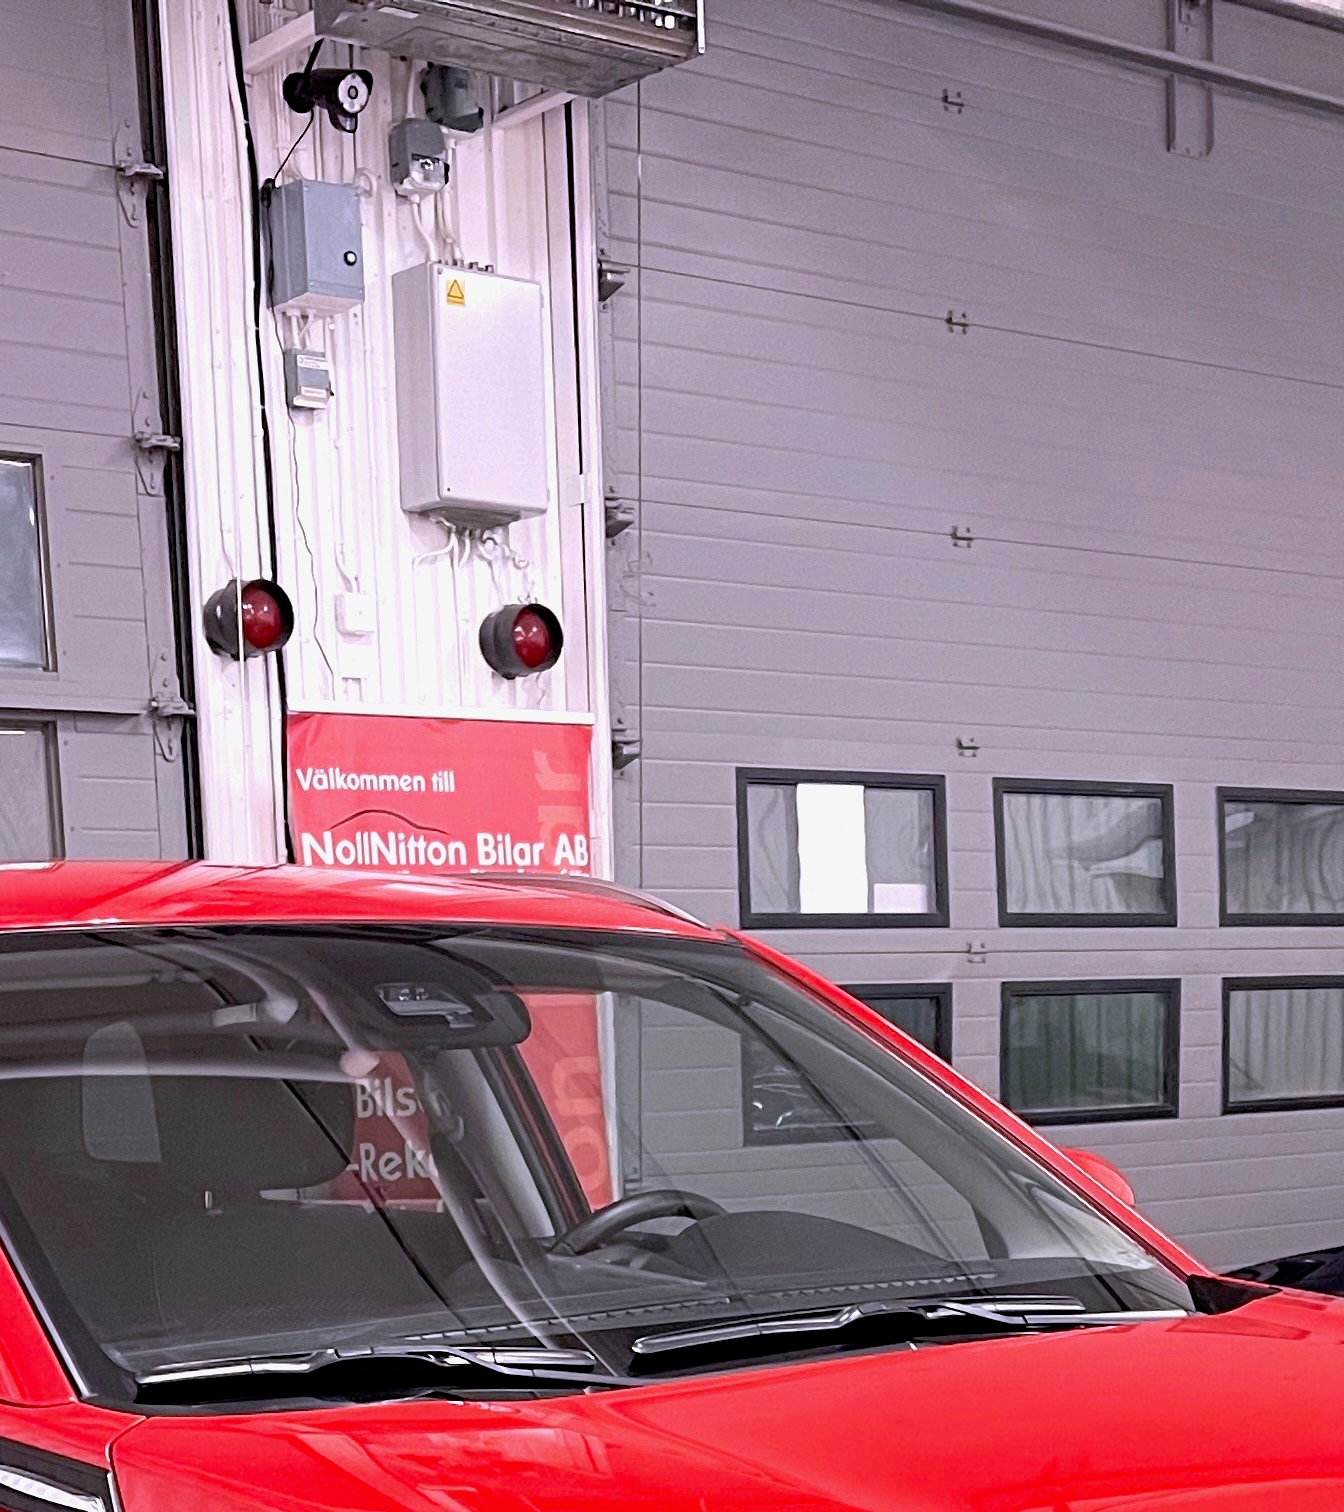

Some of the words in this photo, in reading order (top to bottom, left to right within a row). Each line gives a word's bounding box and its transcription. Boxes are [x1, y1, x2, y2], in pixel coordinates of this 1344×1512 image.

[295, 767, 426, 793] Välkommen
[431, 770, 456, 793] till
[300, 830, 468, 867] NollNitton
[476, 832, 545, 867] Bilar
[553, 833, 589, 867] AB
[356, 1076, 424, 1119] Bils
